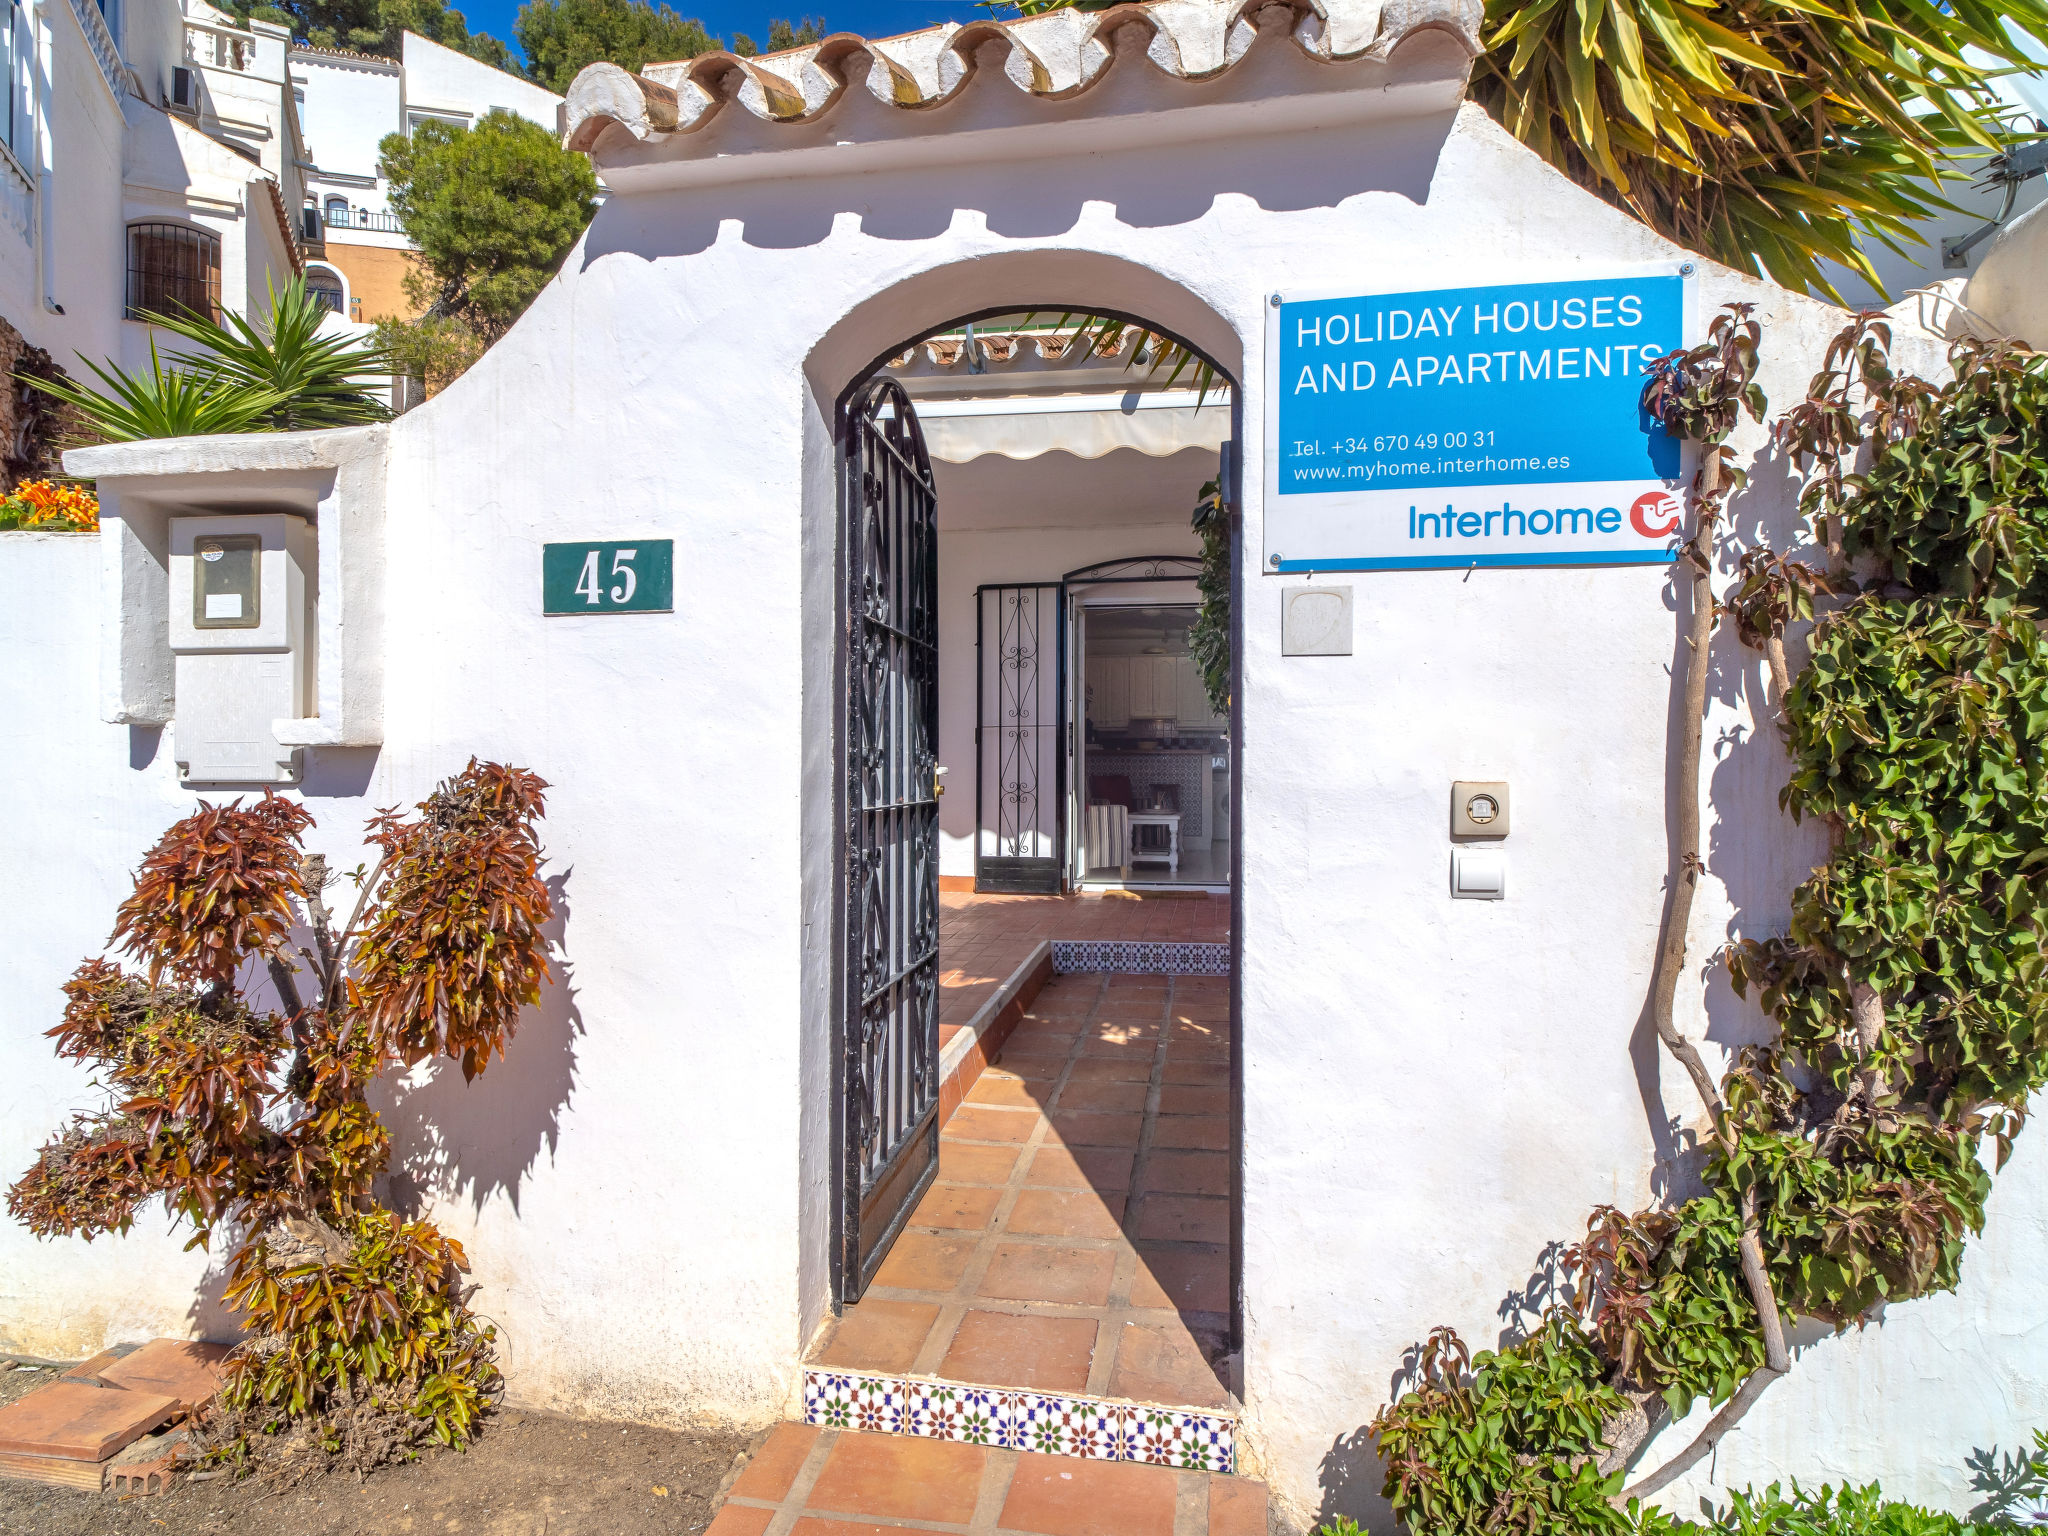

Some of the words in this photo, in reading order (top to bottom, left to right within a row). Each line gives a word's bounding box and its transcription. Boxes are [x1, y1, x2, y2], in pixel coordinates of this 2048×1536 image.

[1297, 305, 1463, 348] HOLIDAY
[1473, 294, 1643, 335] HOUSES
[1294, 359, 1376, 395] AND
[1387, 344, 1664, 390] APARTMENTS
[1294, 440, 1326, 457] Tel.
[1331, 437, 1368, 454] +34
[1374, 435, 1409, 452] 670
[1414, 433, 1438, 450] 49
[1443, 432, 1468, 449] 00
[1473, 430, 1495, 447] 31
[1294, 454, 1570, 481] www.myhome.interhome.es
[1409, 502, 1622, 539] Interhome
[574, 549, 638, 604] 45
